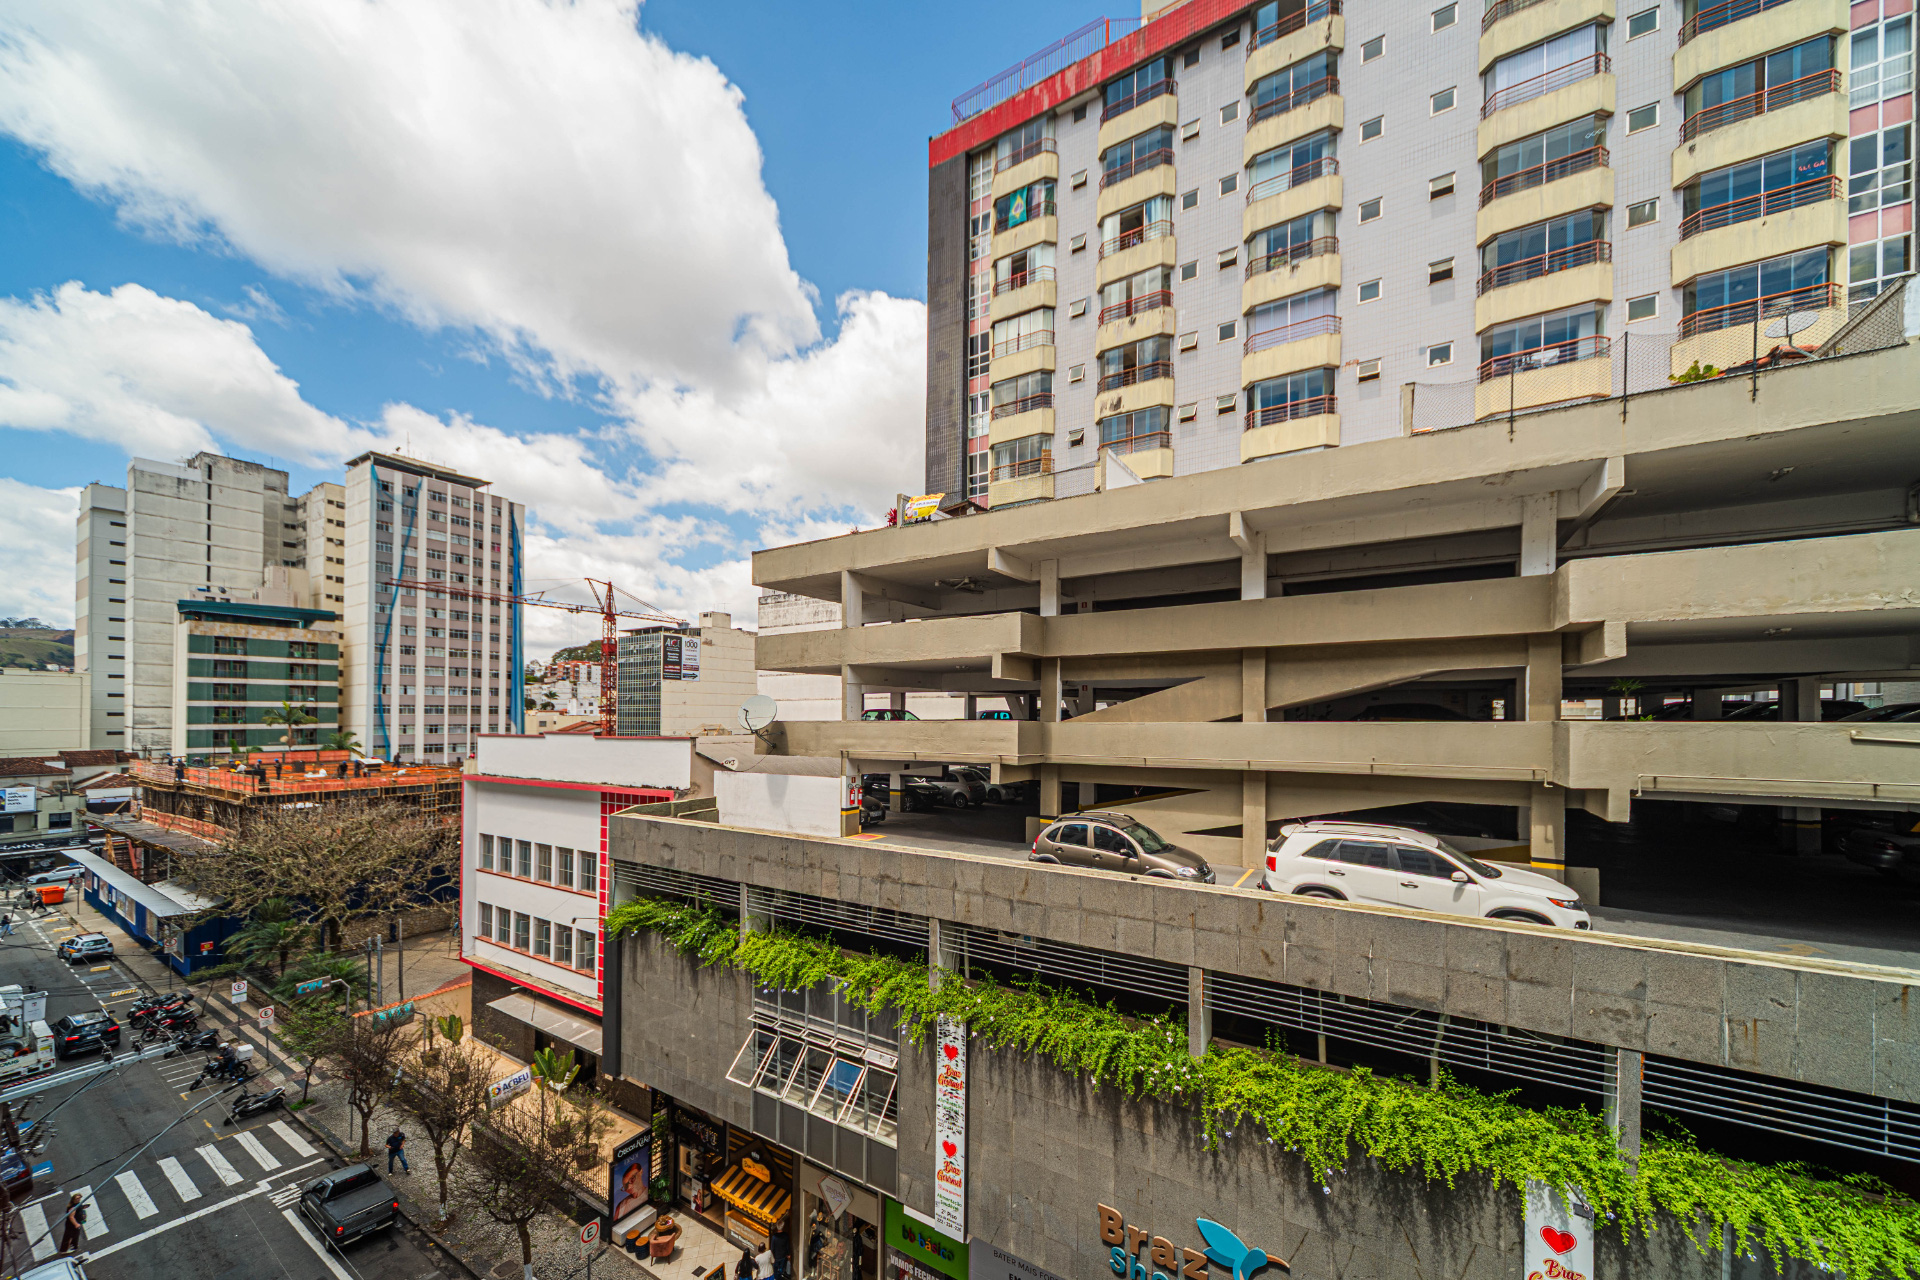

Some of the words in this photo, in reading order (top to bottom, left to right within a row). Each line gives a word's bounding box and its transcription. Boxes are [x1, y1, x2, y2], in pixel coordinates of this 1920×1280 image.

[944, 1063, 962, 1080] Braz
[503, 1072, 529, 1091] ACBEU
[944, 1160, 962, 1177] Braz
[937, 1169, 963, 1189] Gourmet
[947, 1210, 958, 1221] Piso
[587, 1226, 594, 1239] E
[1097, 1202, 1209, 1280] Braz
[890, 1254, 914, 1275] VAMOS
[993, 1249, 1016, 1267] BATER
[1018, 1261, 1038, 1277] MAIS
